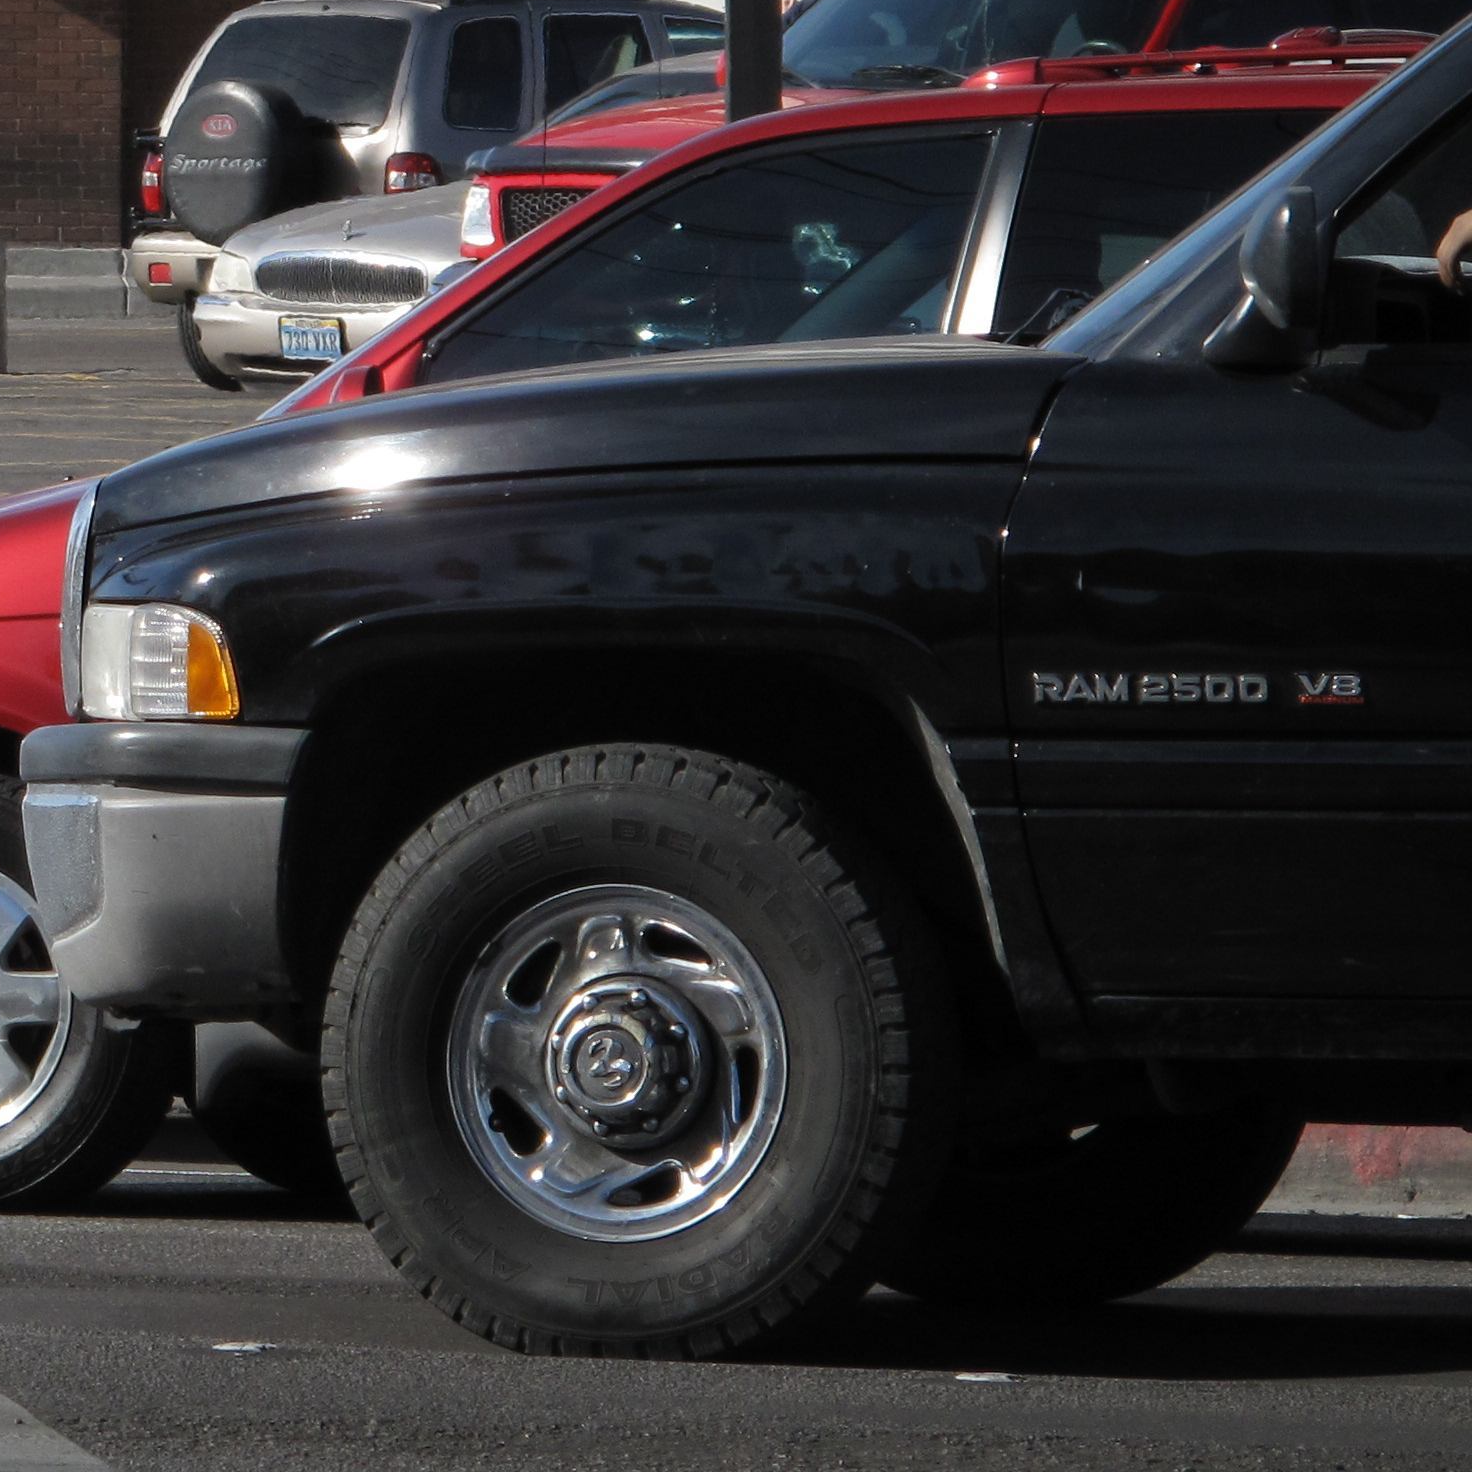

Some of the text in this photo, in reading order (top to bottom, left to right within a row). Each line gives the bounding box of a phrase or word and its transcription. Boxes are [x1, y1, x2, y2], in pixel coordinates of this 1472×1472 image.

[209, 119, 232, 130] KIA
[170, 153, 267, 174] Sportage
[1032, 672, 1361, 703] RAM 2500 V8
